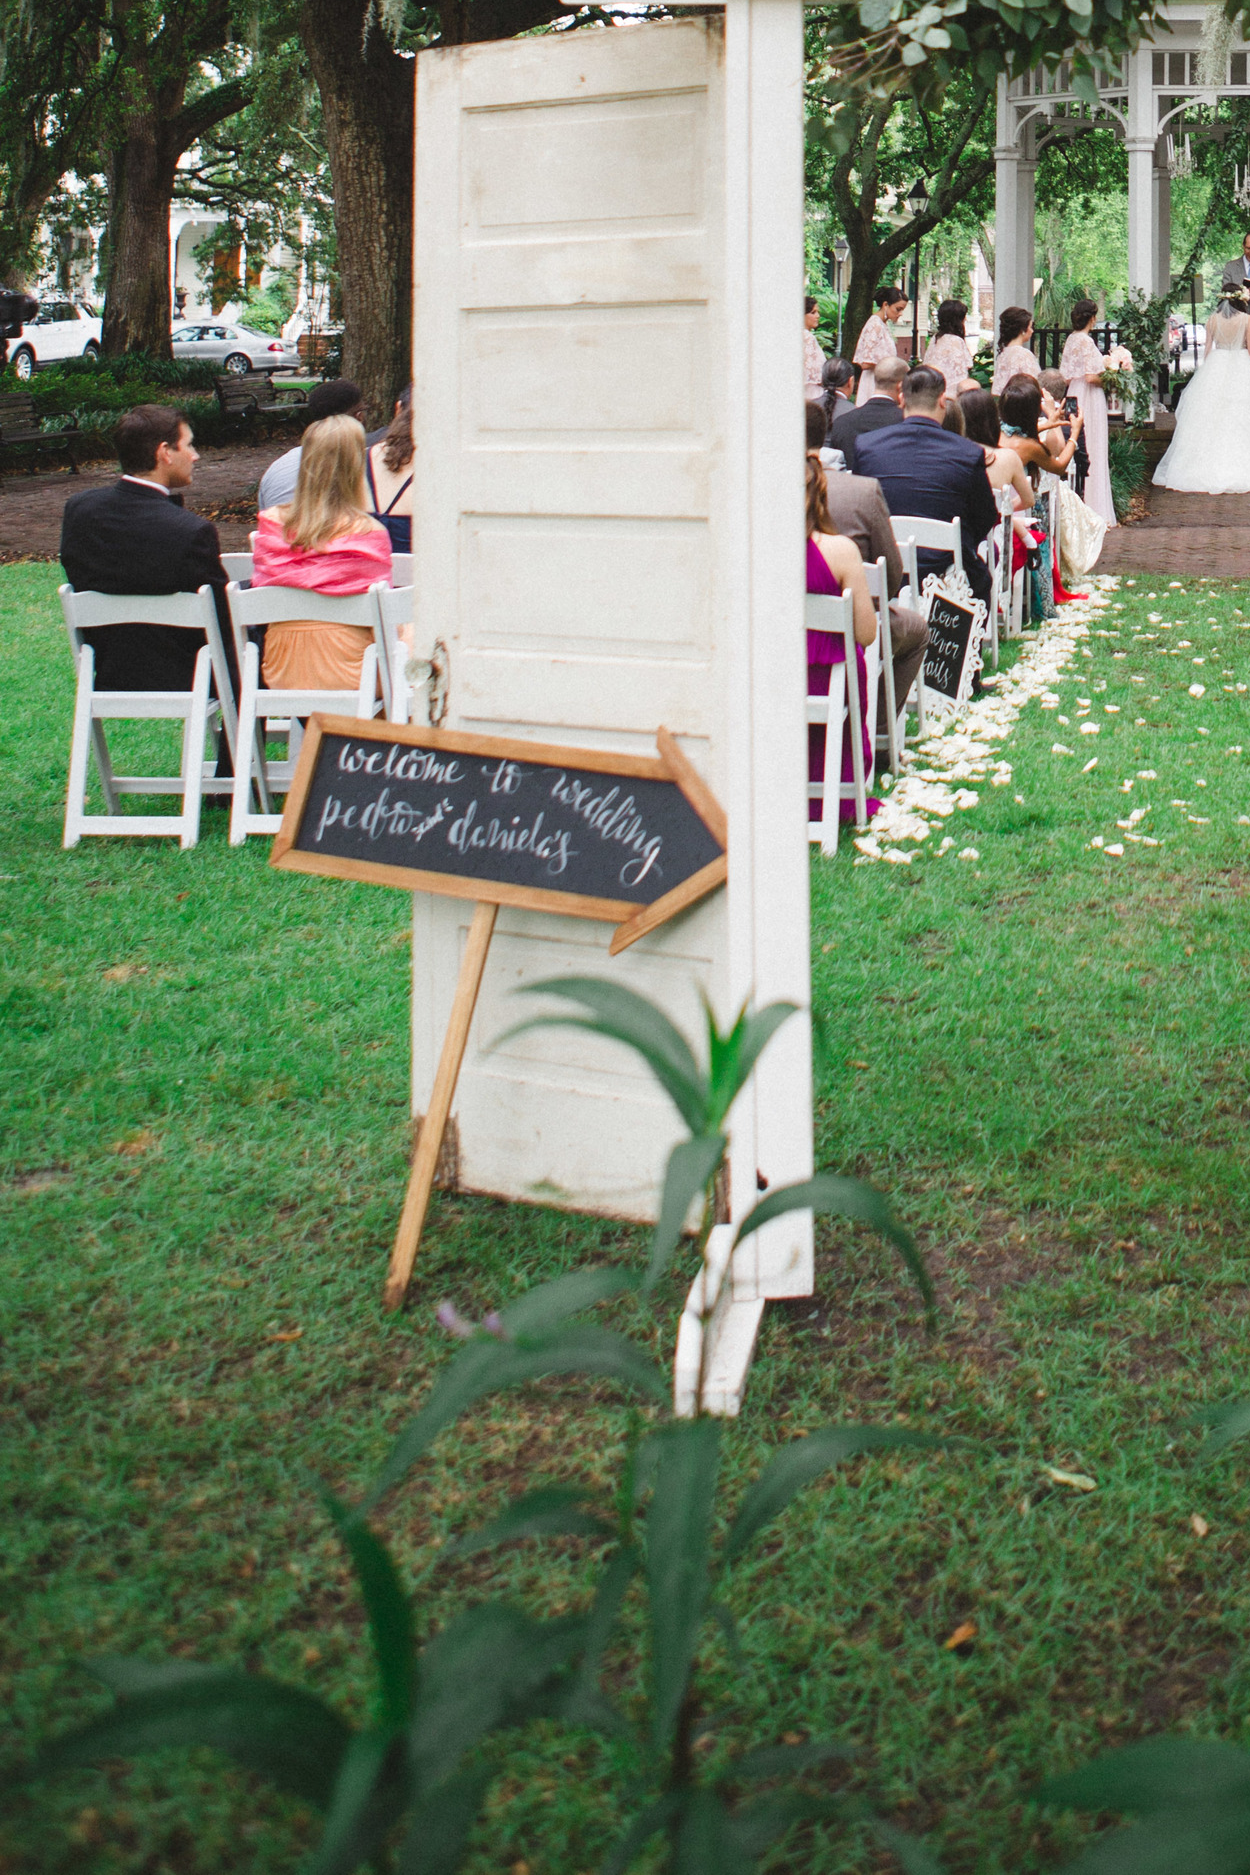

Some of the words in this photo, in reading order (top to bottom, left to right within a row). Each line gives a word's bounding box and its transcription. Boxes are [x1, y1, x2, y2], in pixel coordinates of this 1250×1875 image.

[921, 649, 953, 689] fails
[928, 627, 960, 659] never
[339, 742, 465, 783] welcome
[480, 759, 534, 795] to
[315, 787, 422, 841] pedro
[447, 799, 580, 876] daniela's
[542, 768, 664, 887] wedding
